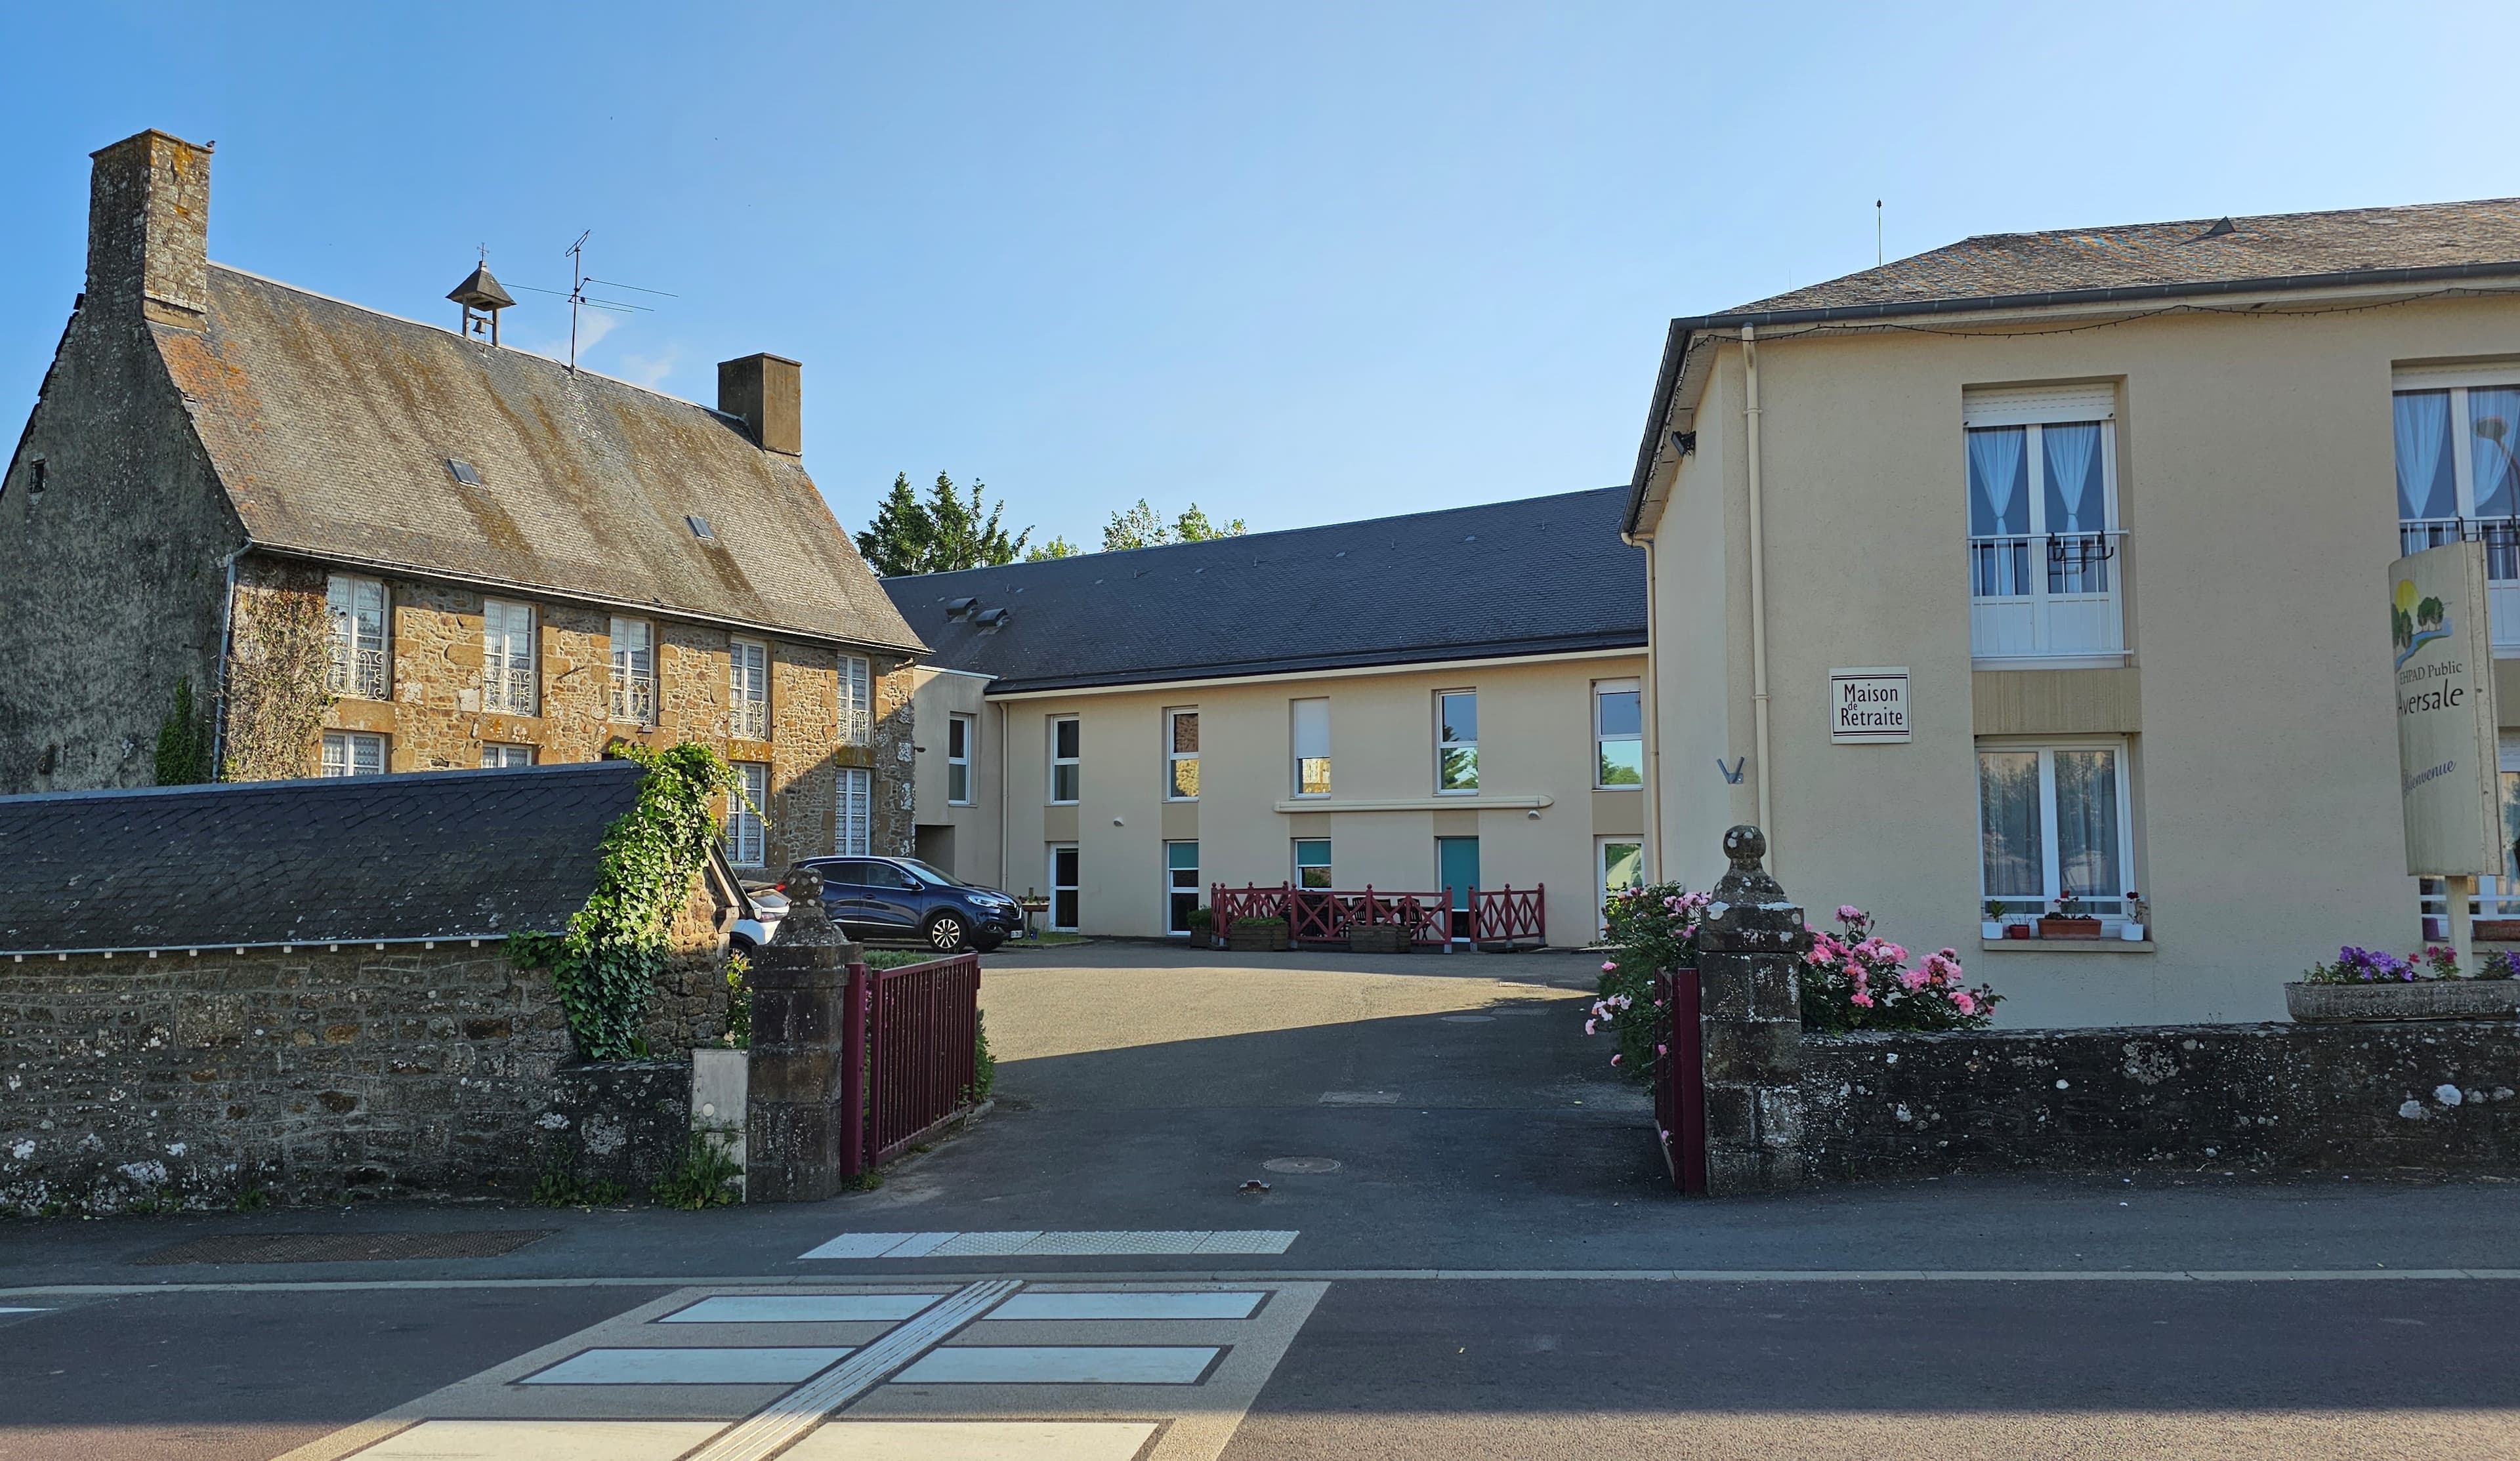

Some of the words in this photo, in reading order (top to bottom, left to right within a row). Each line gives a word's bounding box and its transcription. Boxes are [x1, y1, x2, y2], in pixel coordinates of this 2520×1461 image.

[2399, 667, 2426, 686] EHPAD
[2427, 661, 2463, 678] Public
[1844, 683, 1898, 703] Maison
[2397, 678, 2464, 718] Aversale
[1847, 701, 1858, 710] de
[1841, 707, 1903, 726] Retraite
